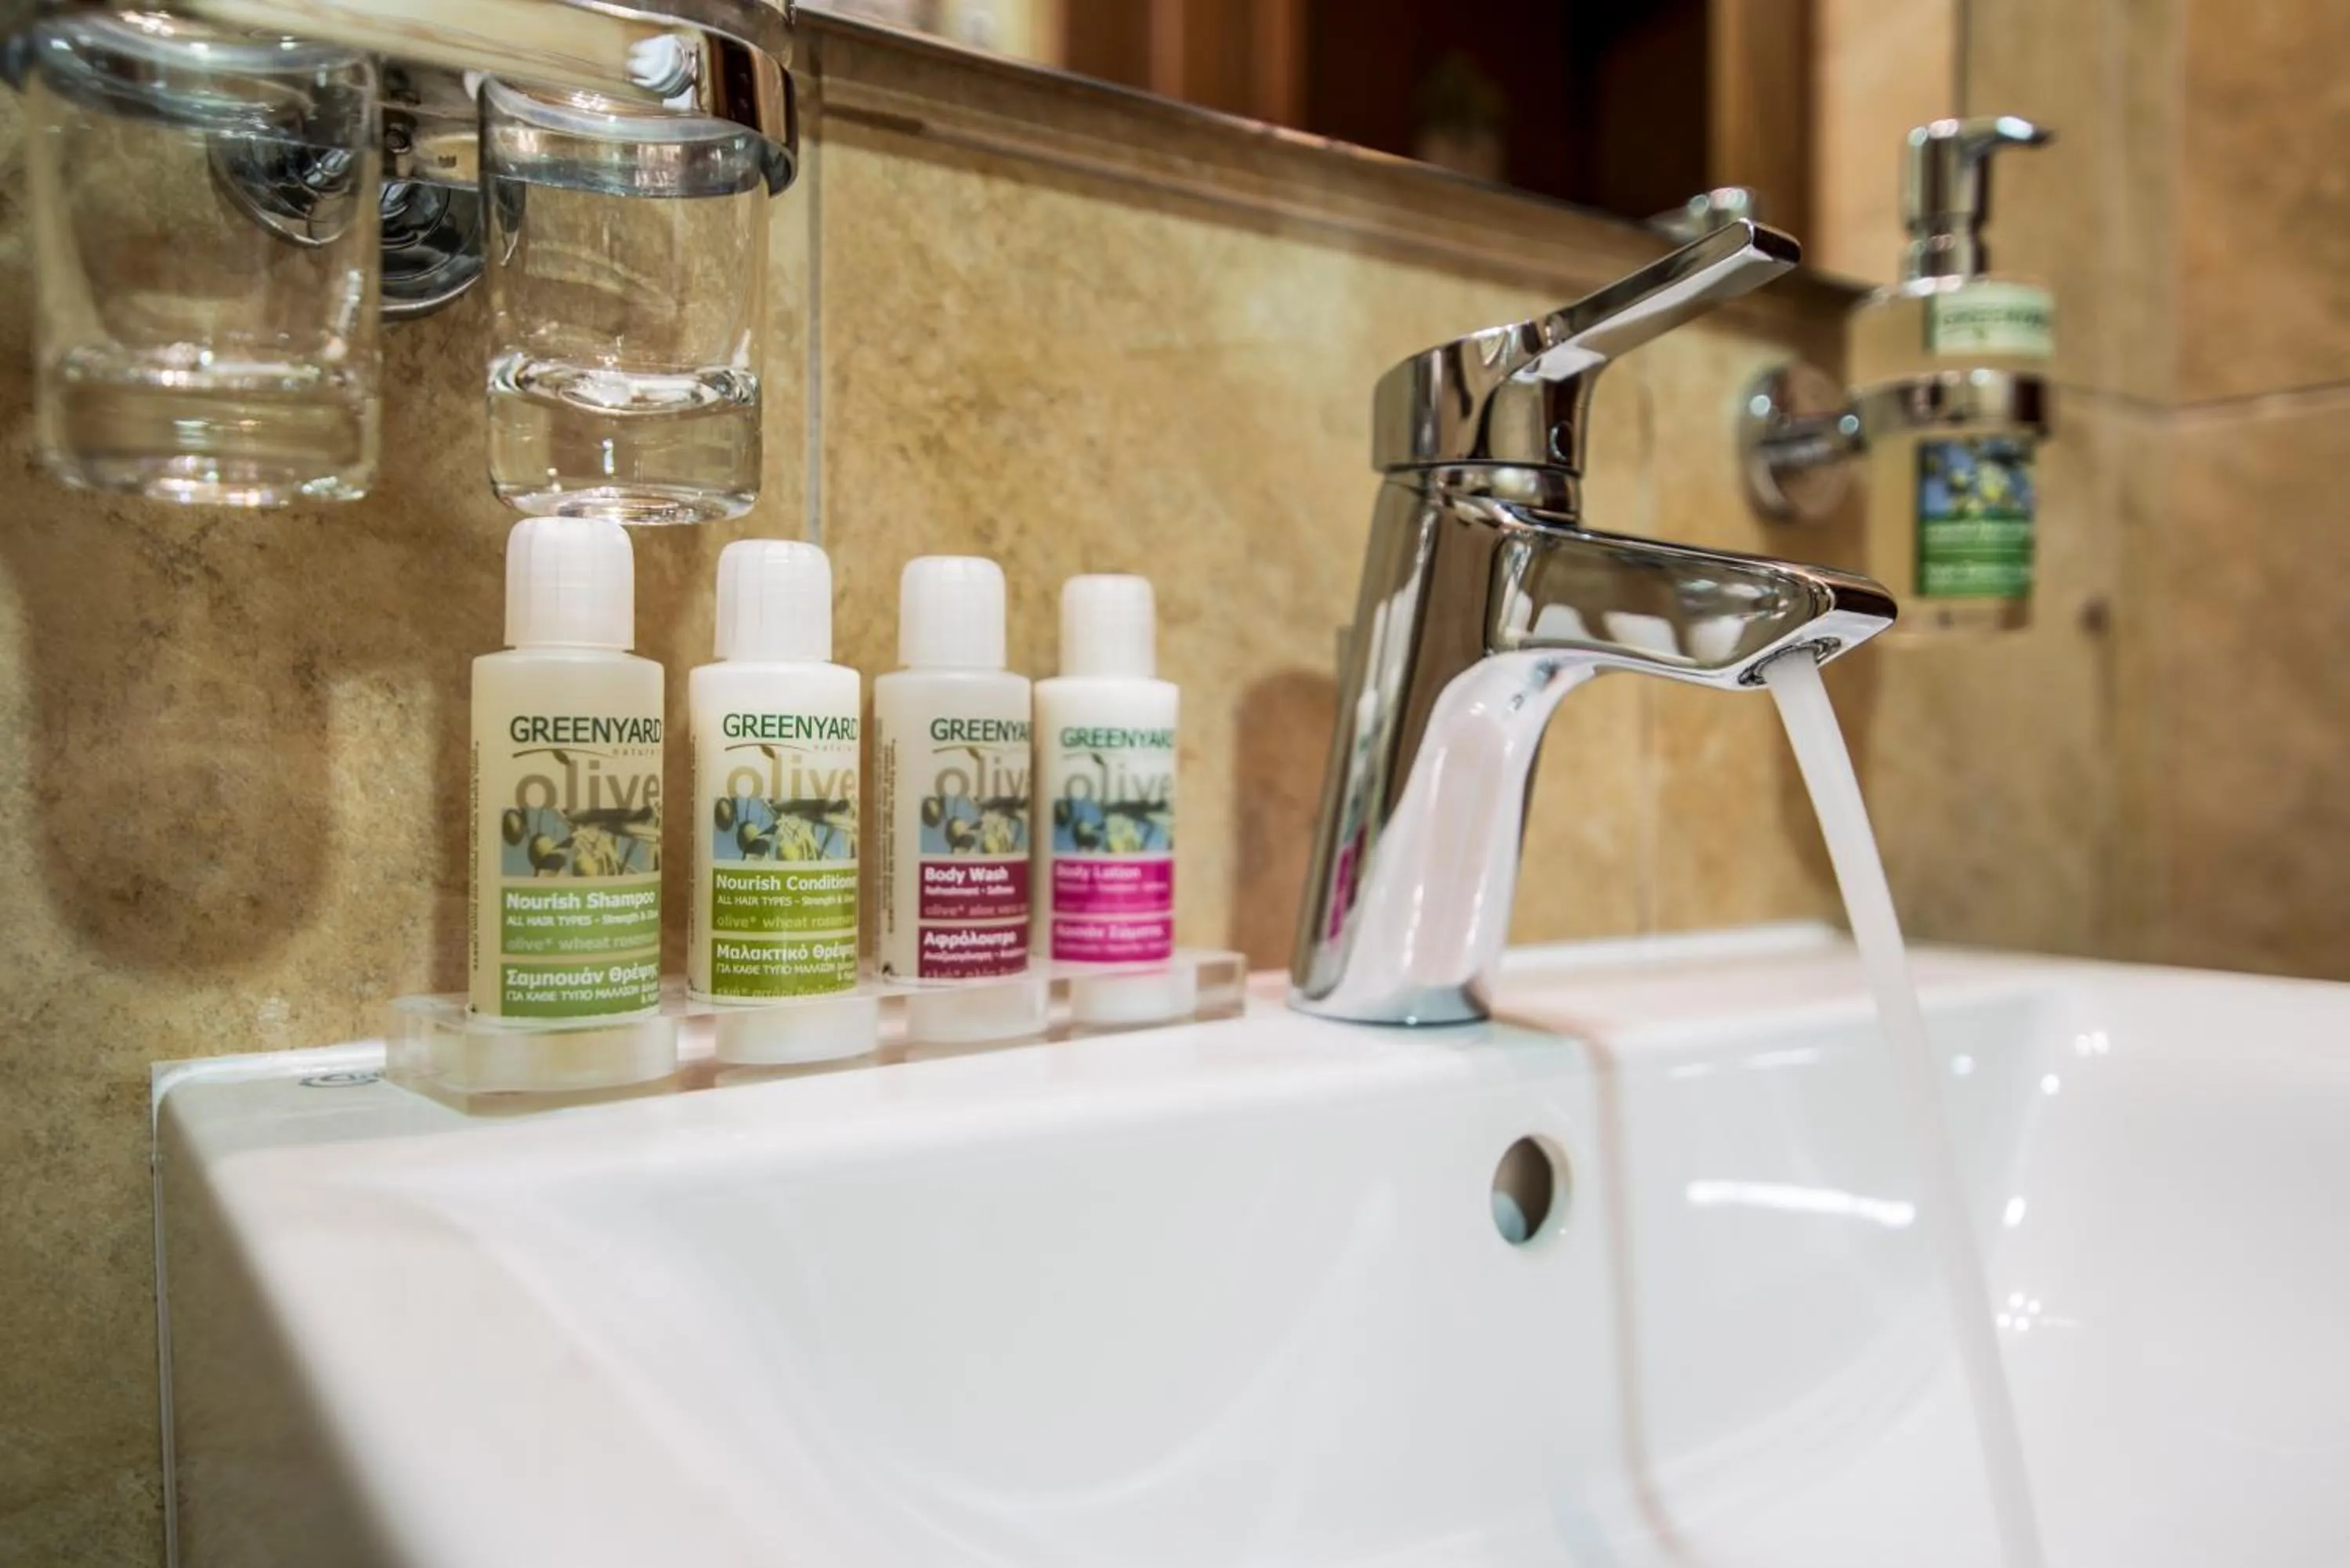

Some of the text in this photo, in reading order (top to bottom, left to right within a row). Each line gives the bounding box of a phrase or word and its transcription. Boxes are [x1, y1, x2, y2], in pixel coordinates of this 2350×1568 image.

[511, 716, 662, 743] GREENYARD
[723, 714, 857, 740] GREENYARD
[931, 718, 1032, 742] GREENYA
[515, 759, 660, 810] olive
[727, 753, 855, 800] olive
[935, 756, 1031, 797] oliv
[717, 874, 857, 891] Nourish Condition
[925, 865, 1009, 885] Body Wash
[506, 890, 656, 910] Nourish Shampoo
[717, 895, 732, 905] ALL
[733, 895, 759, 906] HAIR
[762, 895, 792, 907] TYPES
[506, 916, 524, 927] ALL
[526, 915, 555, 927] HAIR
[558, 915, 592, 927] TYPES
[762, 915, 808, 928] wheat
[717, 943, 808, 961] Μαλακτικό
[506, 966, 605, 990] Σαμπουάν
